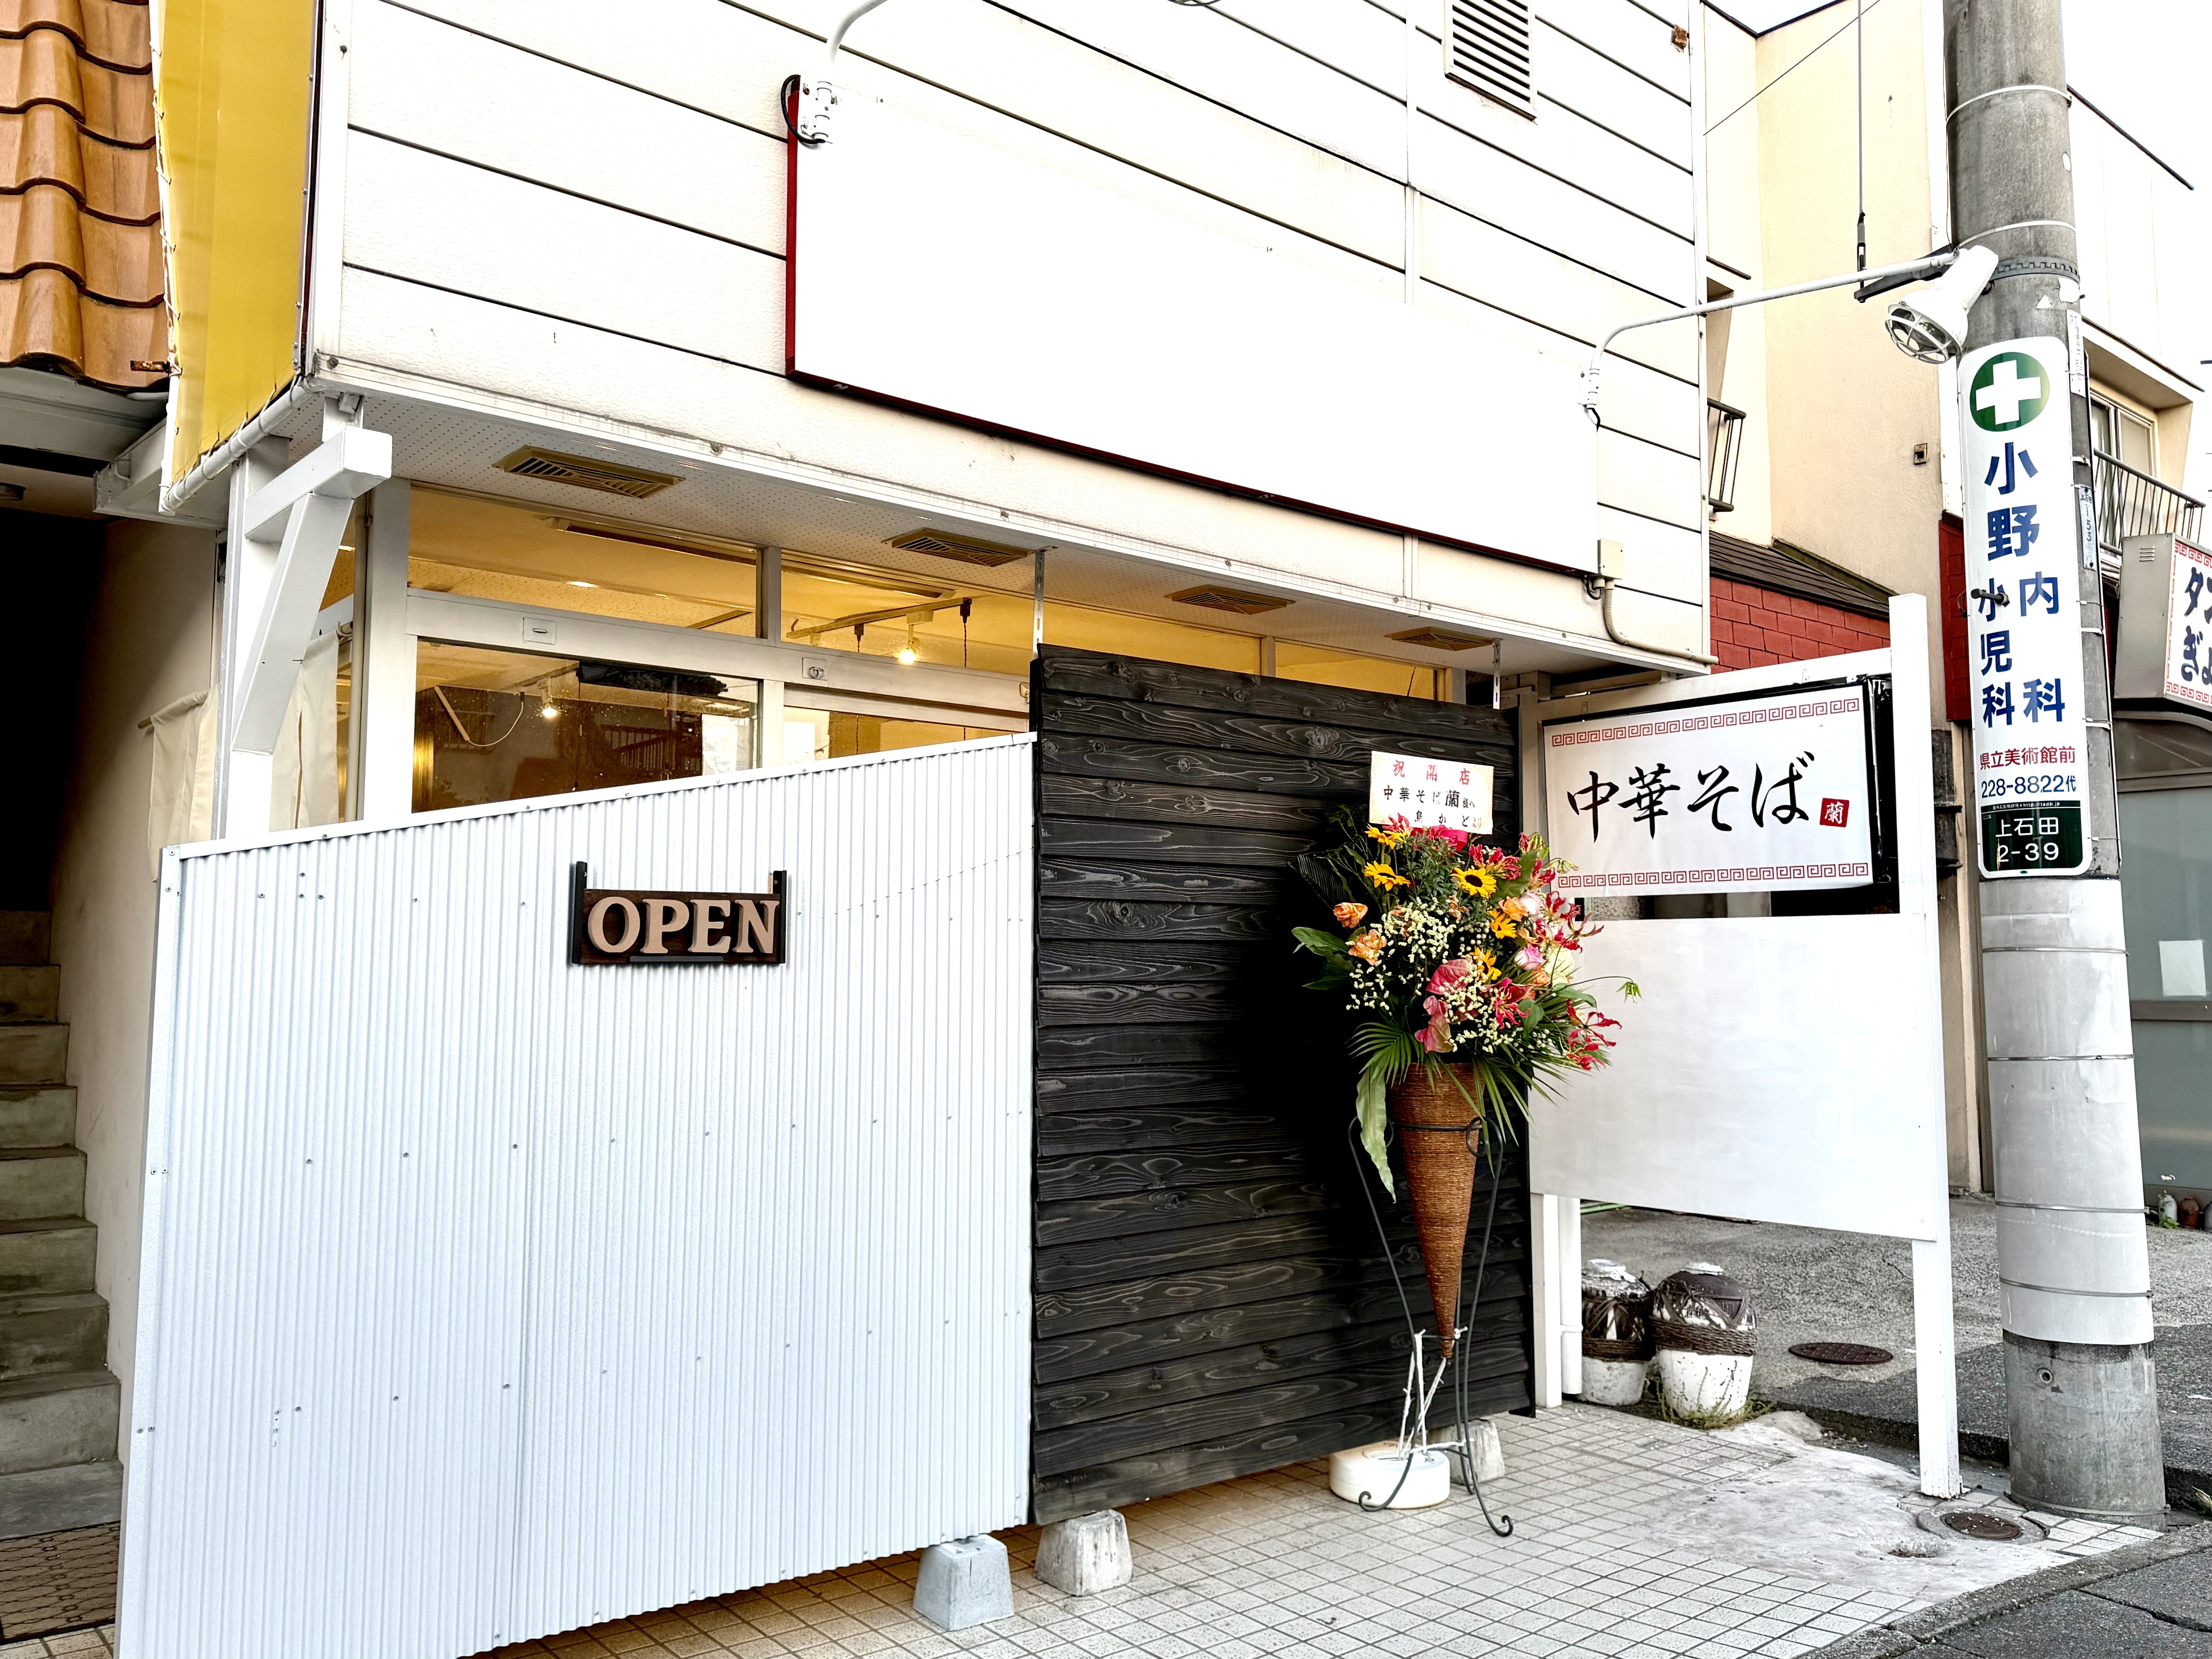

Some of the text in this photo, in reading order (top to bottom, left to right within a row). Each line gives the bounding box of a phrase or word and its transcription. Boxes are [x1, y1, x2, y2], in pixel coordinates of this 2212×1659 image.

[1978, 577, 2015, 728] 小児科
[2019, 571, 2065, 723] 内科
[1393, 759, 1470, 785] 祝開店
[1980, 745, 2075, 770] 県立美術館前
[1566, 750, 1815, 843] 中華そば
[1995, 817, 2059, 837] 上石田
[1997, 842, 2059, 862] 2-39
[587, 896, 780, 954] OPEN
